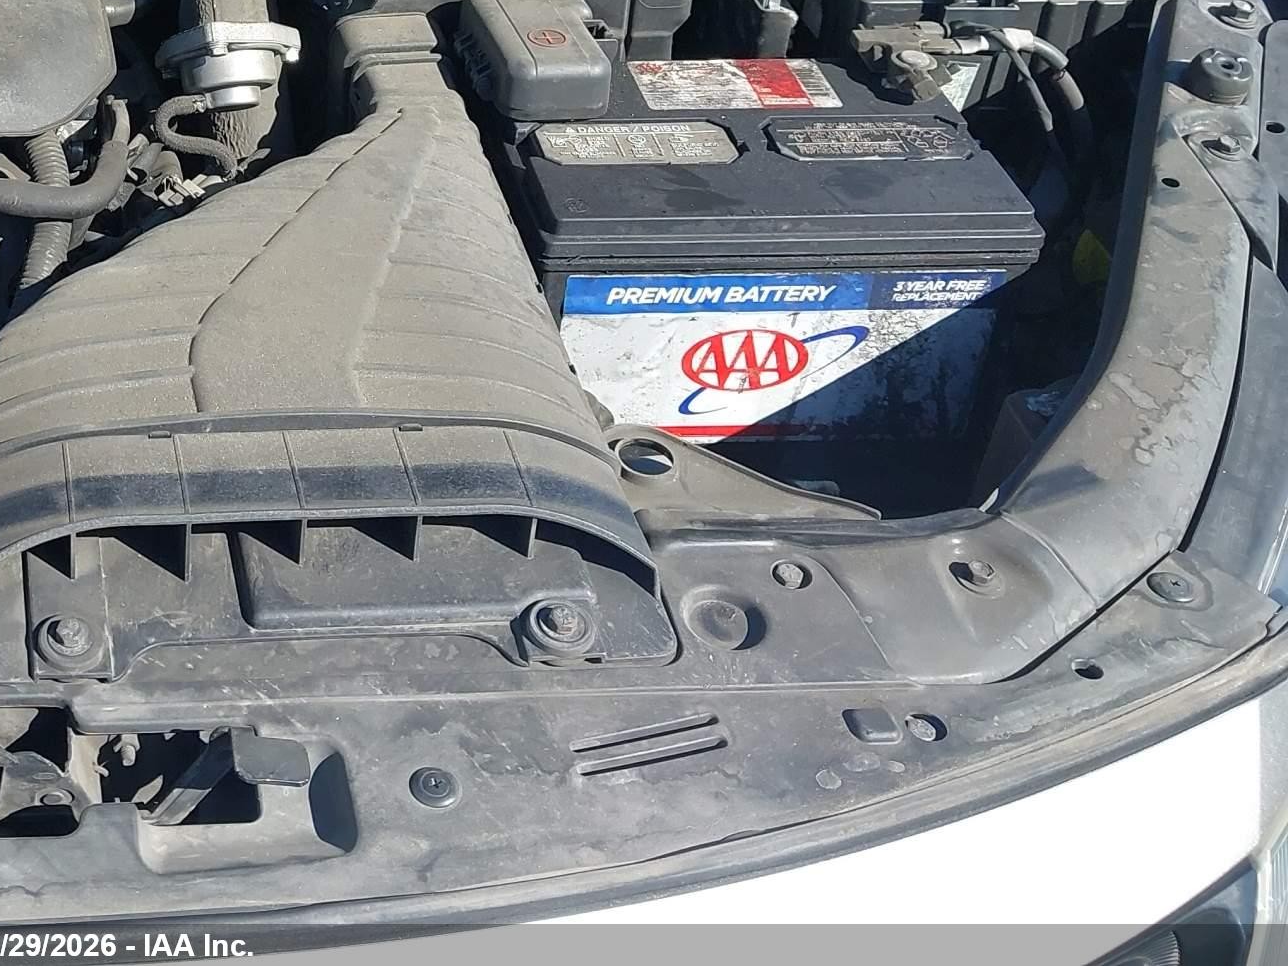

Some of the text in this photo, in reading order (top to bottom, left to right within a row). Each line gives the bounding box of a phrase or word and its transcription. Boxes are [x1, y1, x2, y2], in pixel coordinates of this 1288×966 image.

[578, 125, 629, 133] DANGER
[642, 124, 690, 132] POISON
[893, 280, 987, 291] 3 YEAR FREE
[606, 285, 835, 305] PREMIUM BATTERY
[892, 292, 983, 301] REPLACEMENT
[686, 330, 804, 390] AAA
